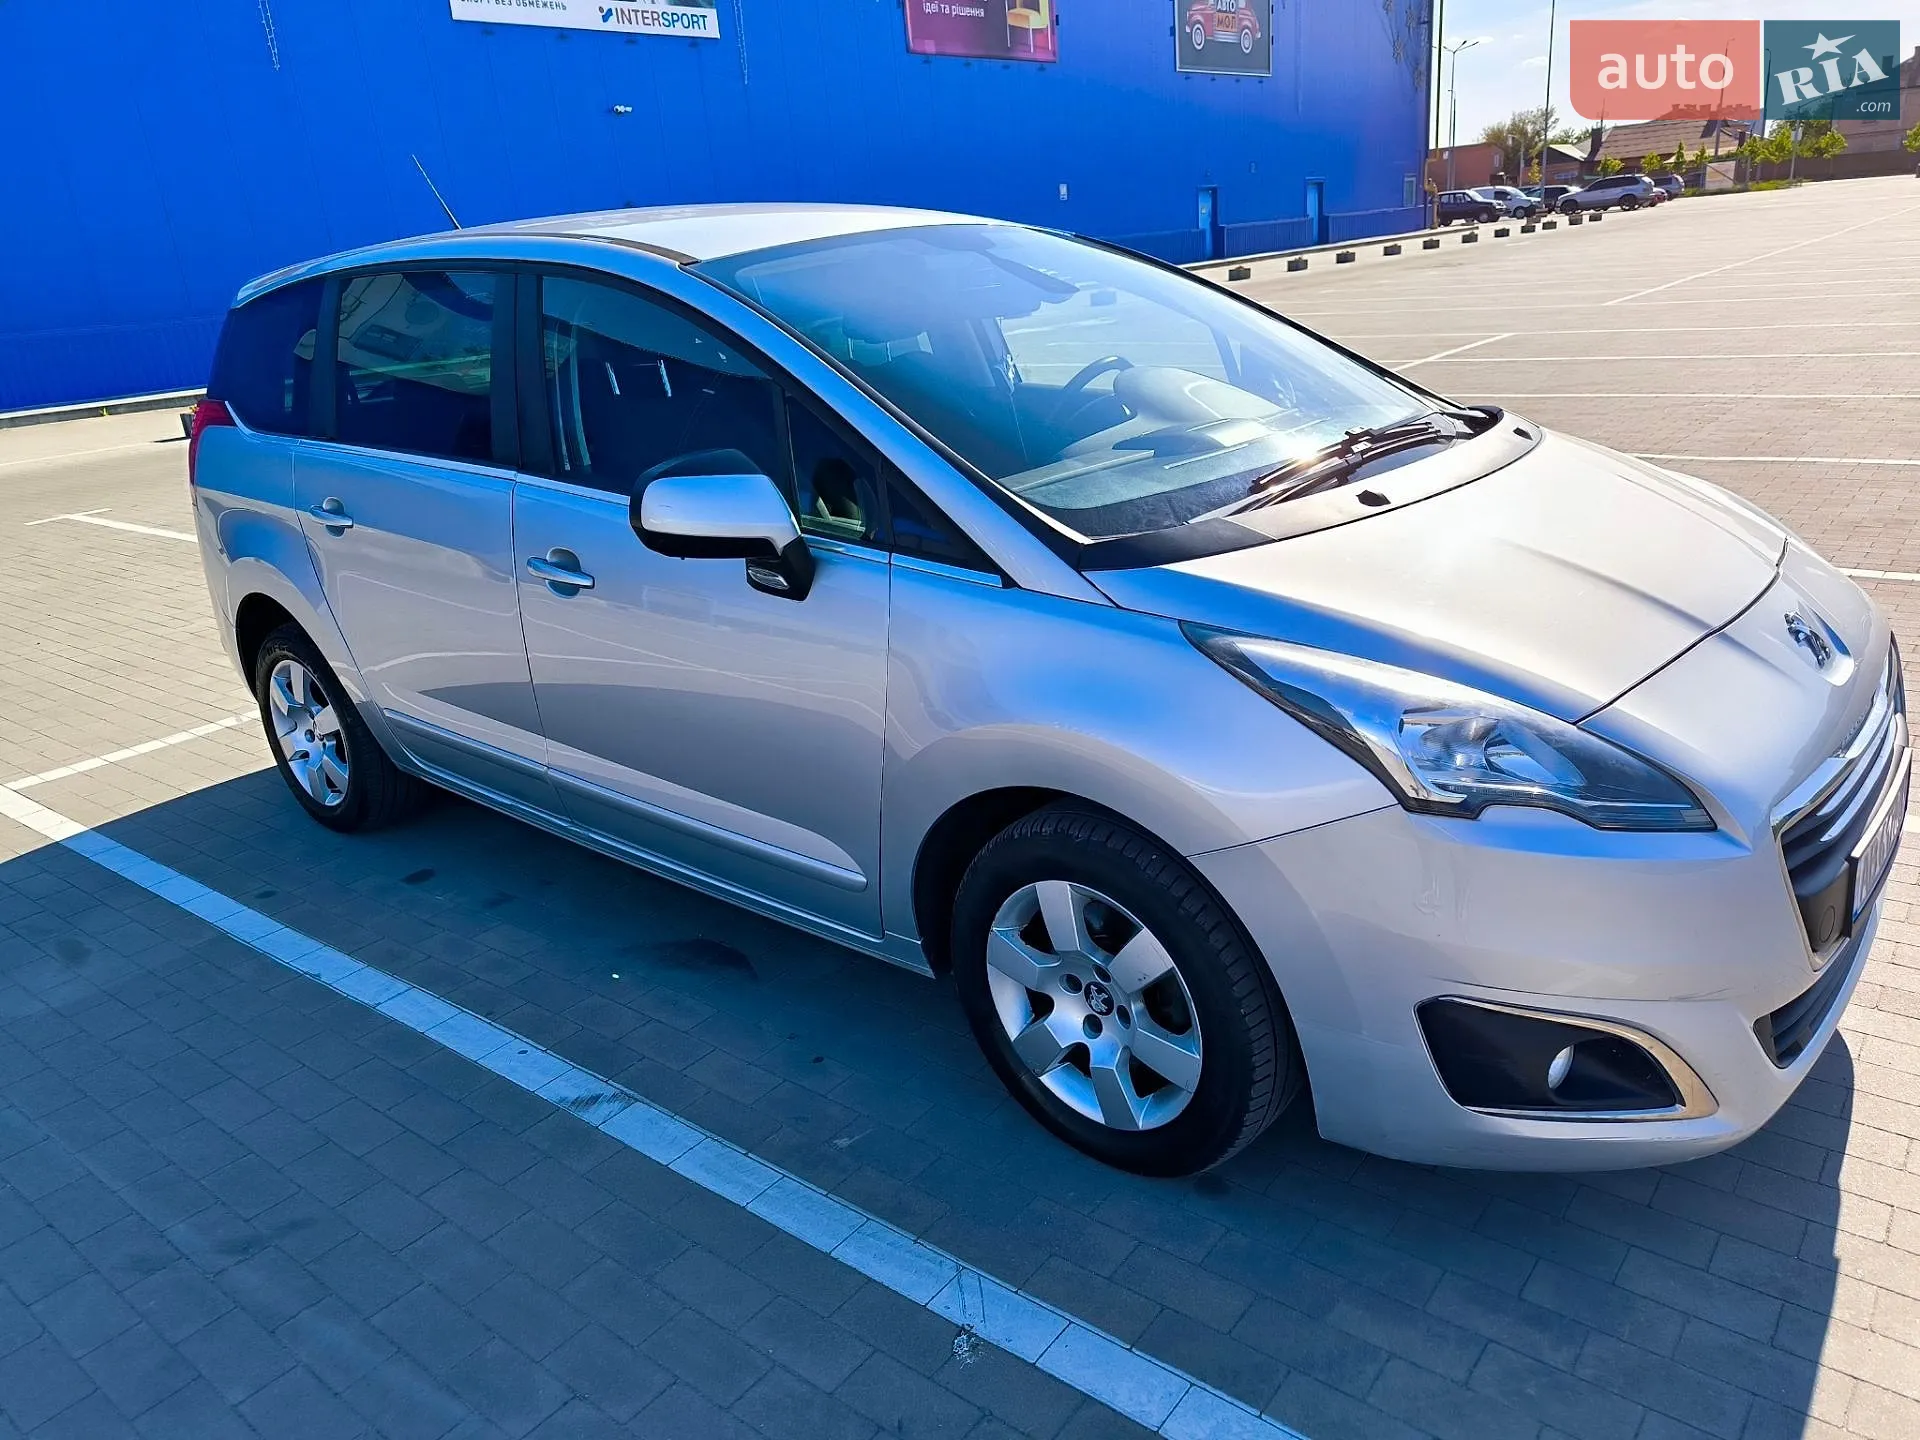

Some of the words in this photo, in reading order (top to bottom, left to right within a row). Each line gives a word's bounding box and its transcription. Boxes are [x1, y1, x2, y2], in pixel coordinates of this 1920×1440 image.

[516, 0, 567, 11] ОБМЕЖЕНЬ
[923, 1, 939, 14] ідеї
[940, 4, 950, 14] та
[952, 4, 984, 17] рішення
[615, 7, 708, 30] INTERSPORT
